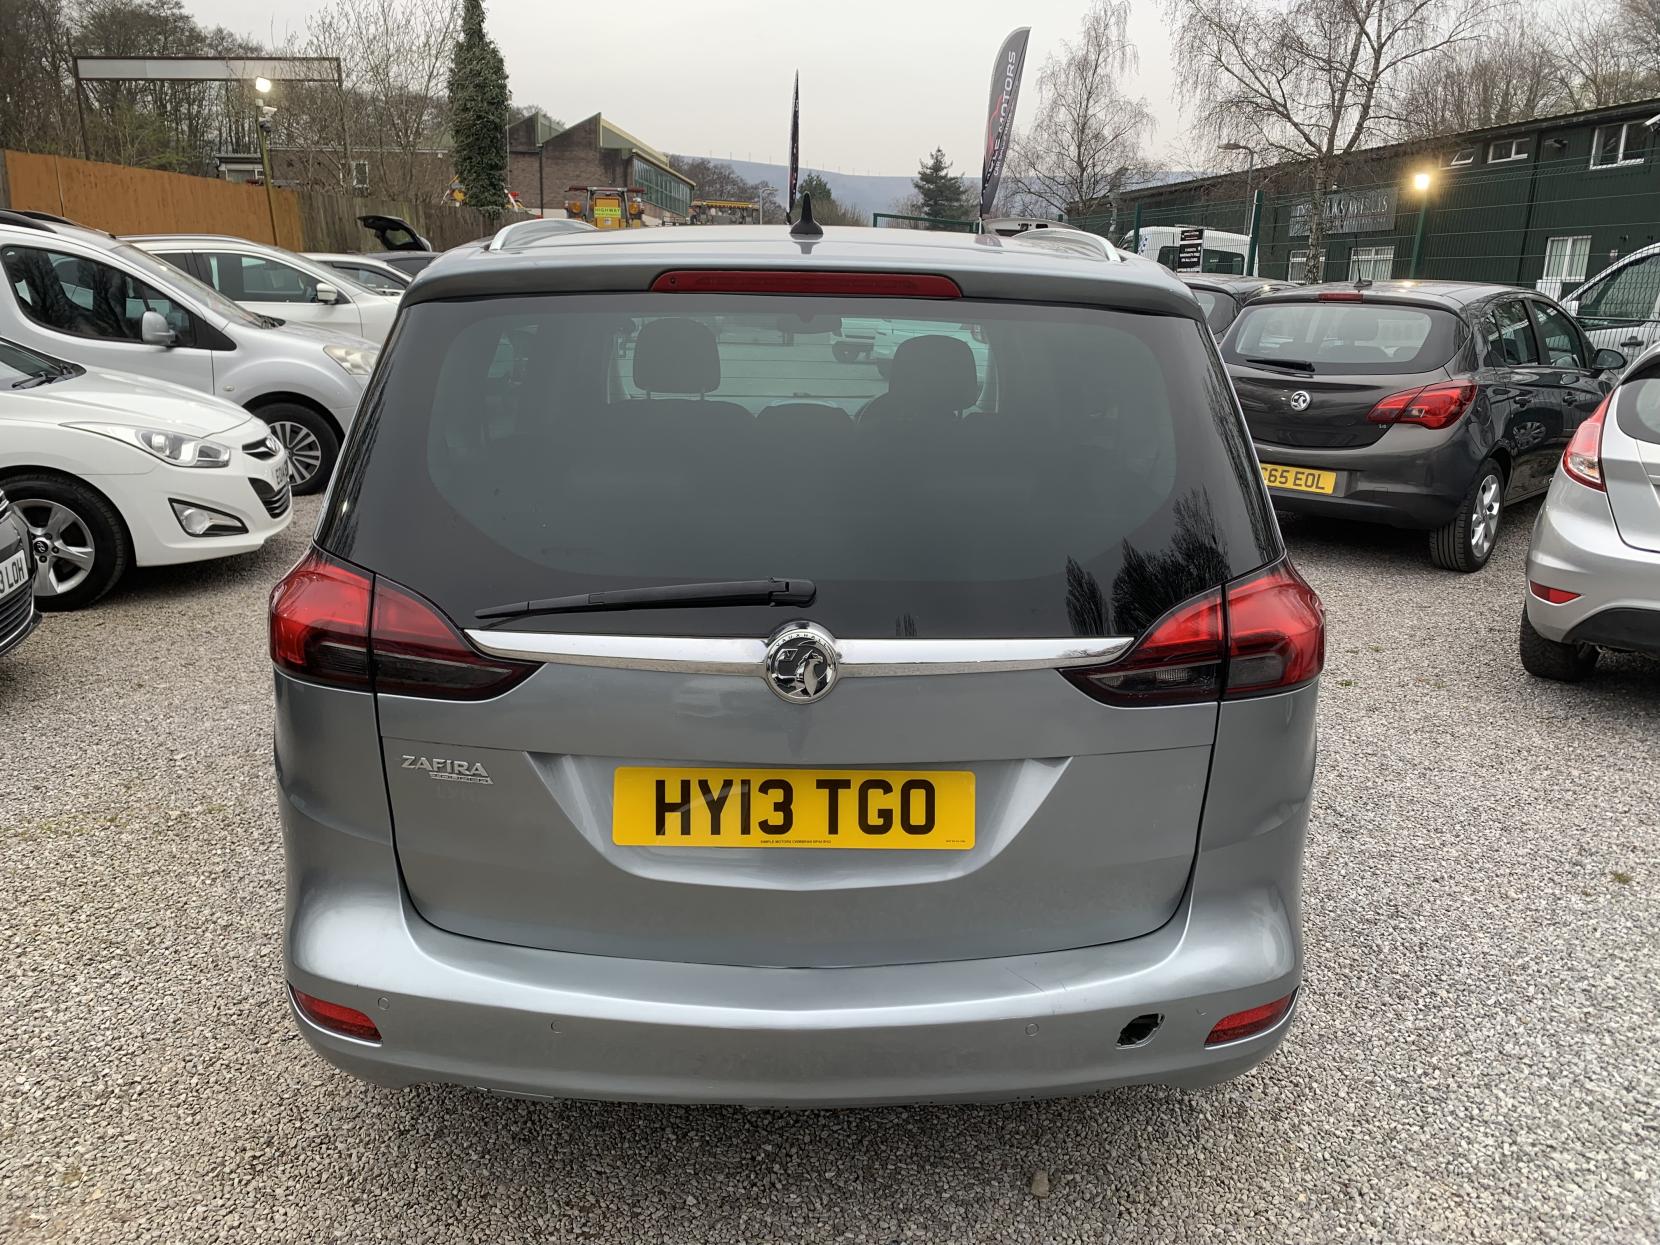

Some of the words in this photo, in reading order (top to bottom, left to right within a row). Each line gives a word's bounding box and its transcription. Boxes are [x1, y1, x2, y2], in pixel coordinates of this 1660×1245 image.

[1293, 471, 1326, 490] EOL
[5, 557, 25, 589] LOH
[776, 633, 827, 647] VAUXHALL
[401, 755, 489, 777] ZAFIRA
[655, 779, 794, 836] HY13
[816, 779, 936, 836] TGO
